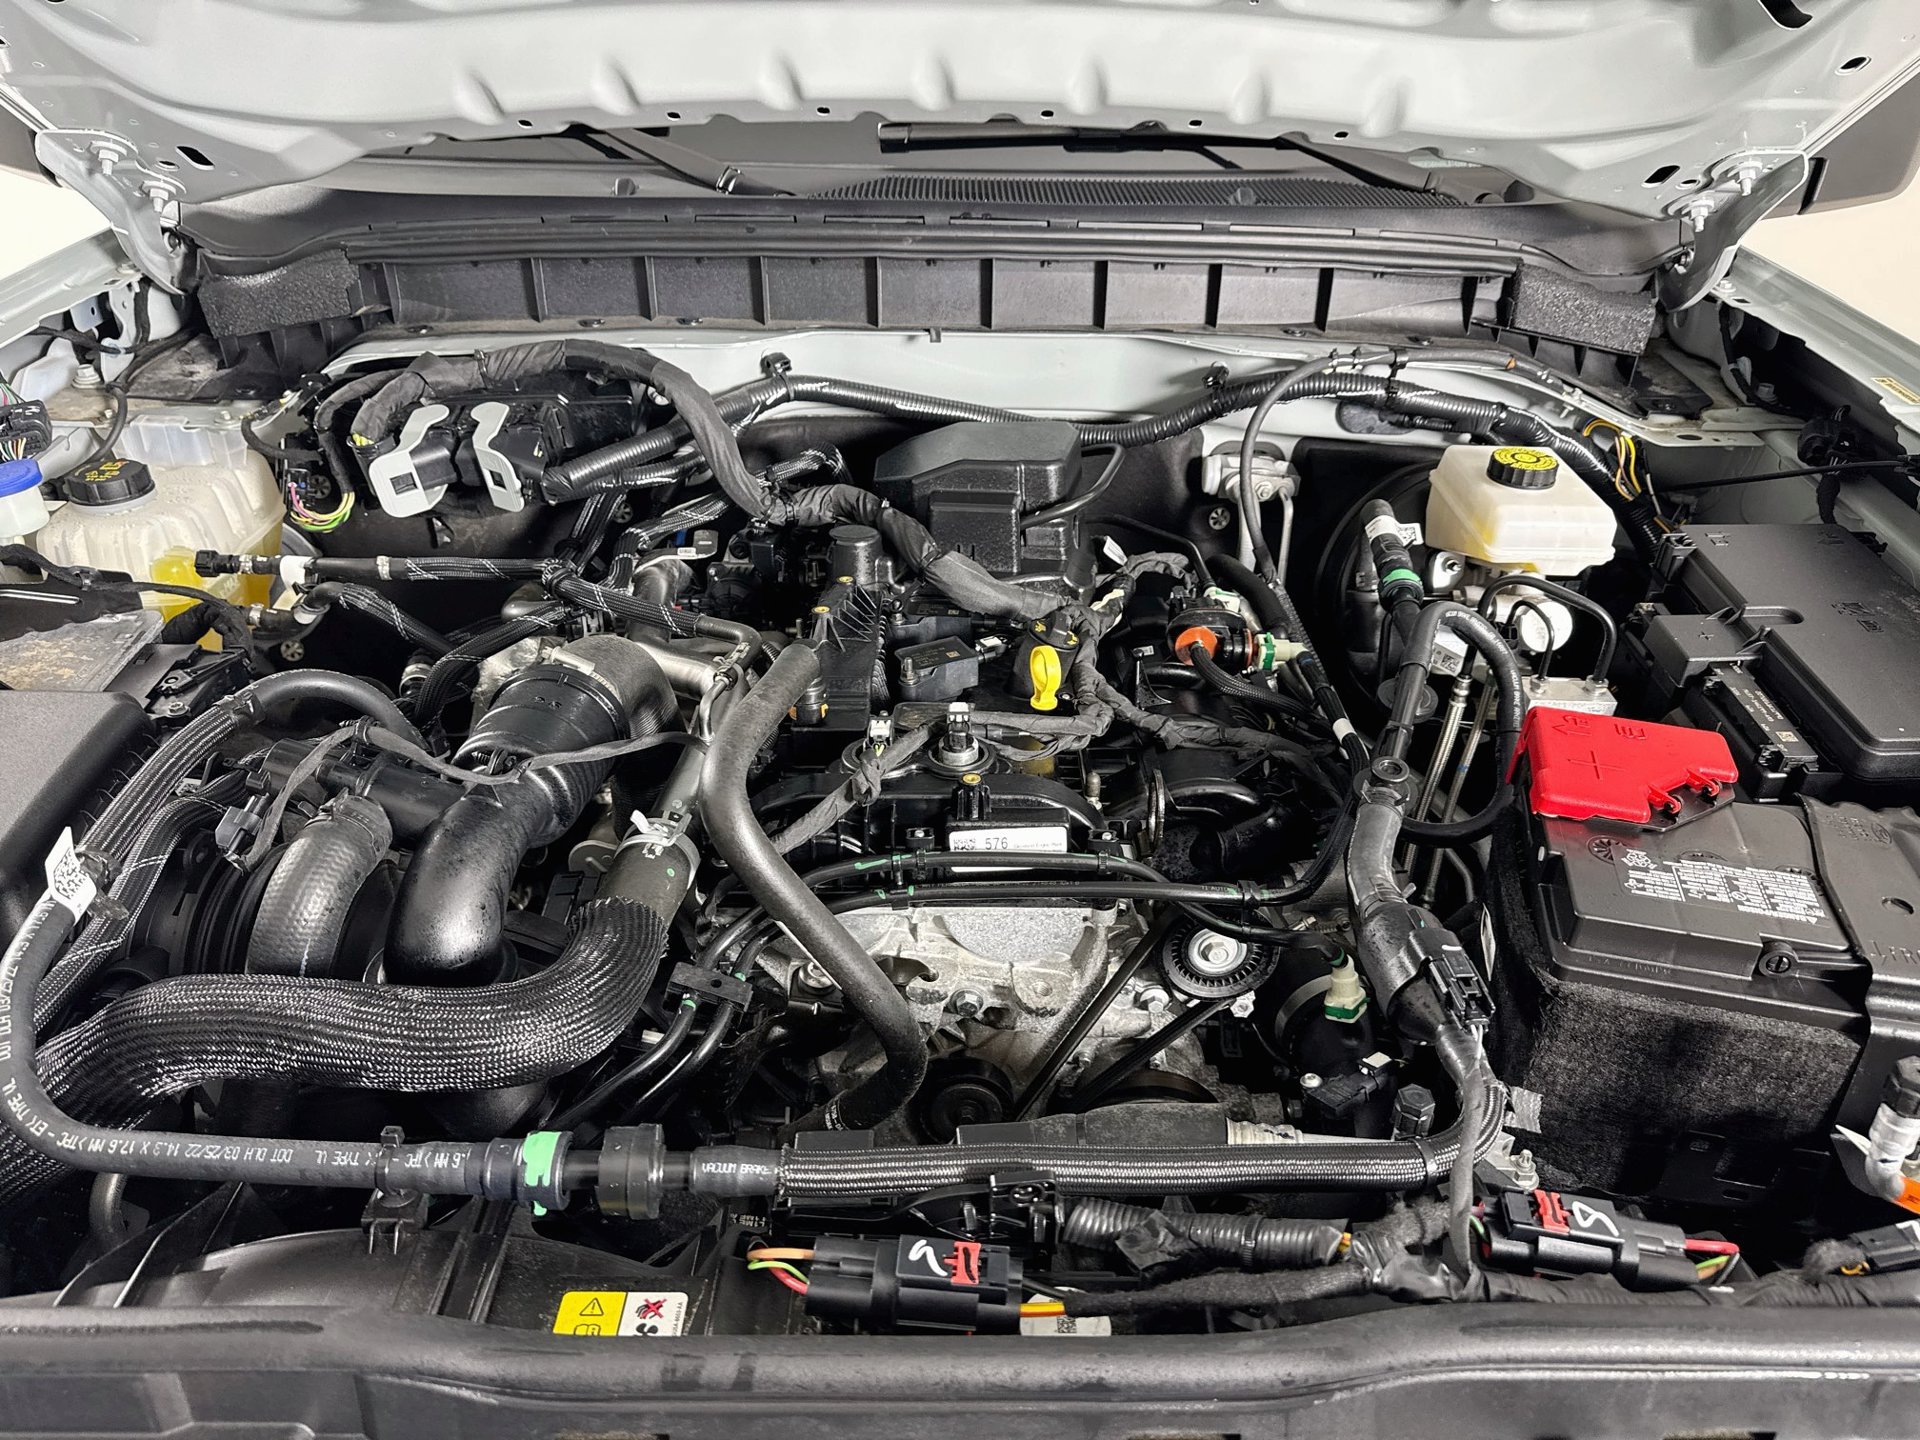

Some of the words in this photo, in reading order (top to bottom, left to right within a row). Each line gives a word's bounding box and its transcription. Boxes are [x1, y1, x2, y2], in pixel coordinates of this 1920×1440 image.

[985, 837, 1009, 850] 576
[6, 1091, 31, 1124] TYPE
[88, 1137, 105, 1151] MM
[109, 1139, 137, 1154] 17.6
[139, 1141, 151, 1155] X
[153, 1141, 181, 1156] 14.3
[185, 1143, 241, 1159] 03/25/22
[270, 1147, 294, 1163] DOT
[331, 1150, 360, 1166] TYPE
[702, 1162, 738, 1174] VACUUM
[740, 1163, 773, 1175] BRAKE
